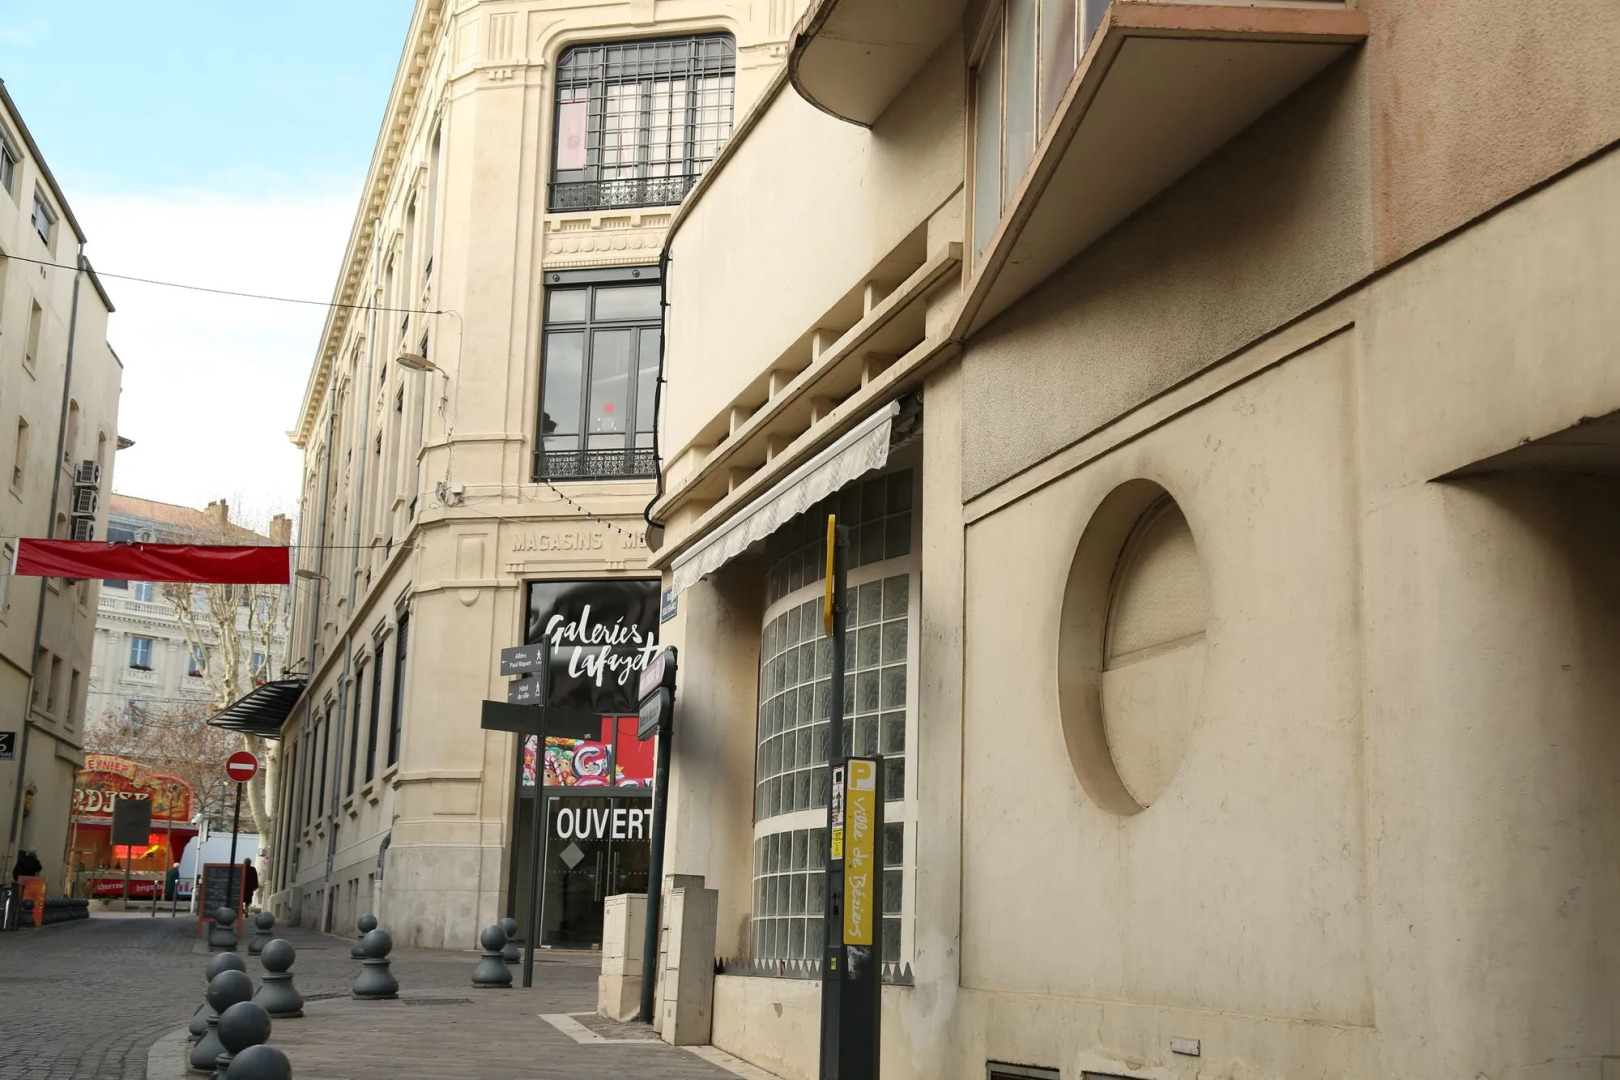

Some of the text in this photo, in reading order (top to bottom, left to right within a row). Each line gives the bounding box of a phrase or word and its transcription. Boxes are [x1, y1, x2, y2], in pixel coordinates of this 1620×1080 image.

[512, 531, 603, 552] MAGASINS
[545, 604, 642, 655] Galeries
[850, 762, 871, 790] P
[556, 807, 653, 840] OUVERT
[853, 846, 868, 868] de
